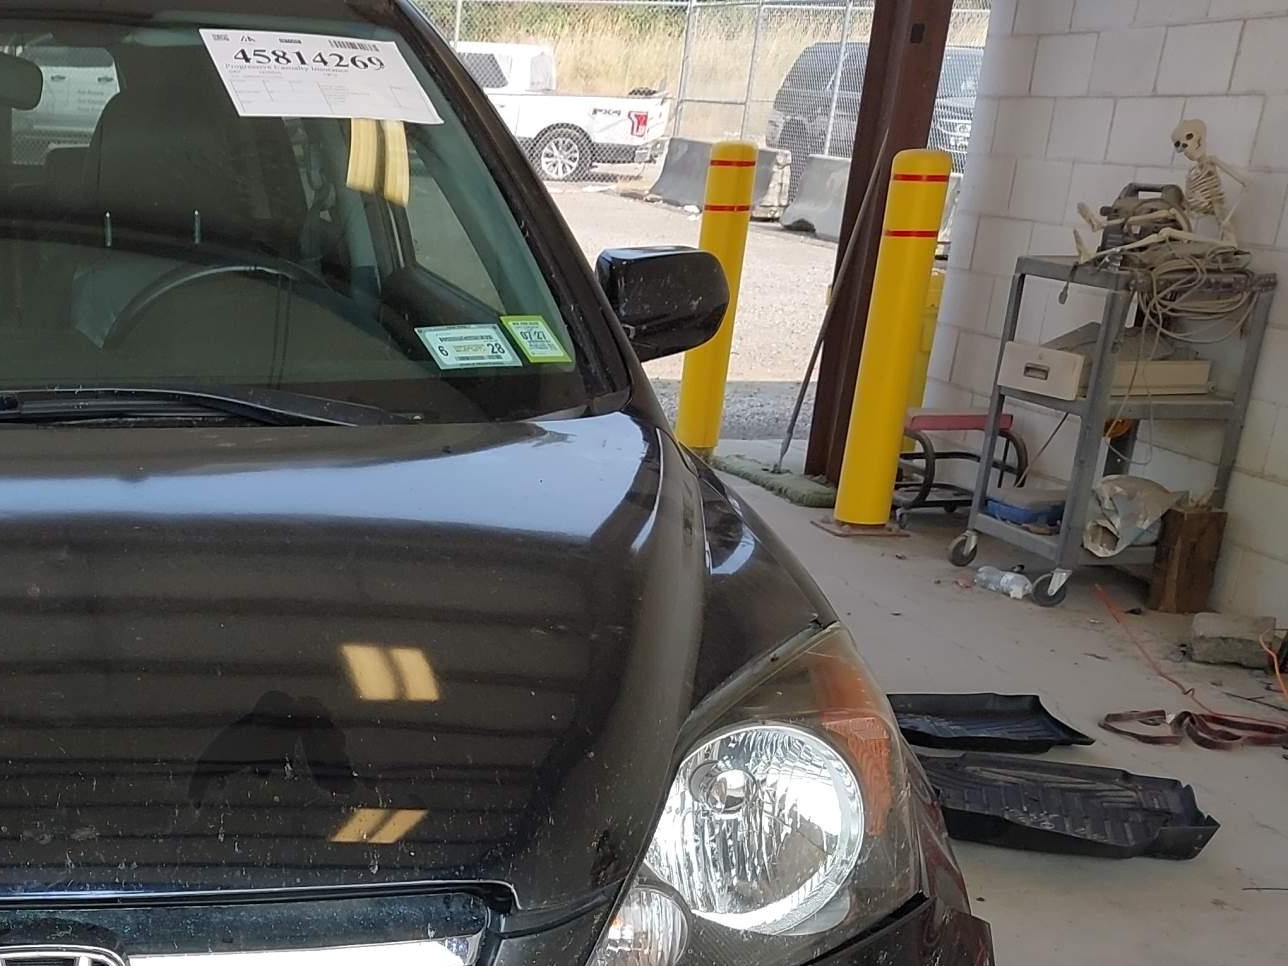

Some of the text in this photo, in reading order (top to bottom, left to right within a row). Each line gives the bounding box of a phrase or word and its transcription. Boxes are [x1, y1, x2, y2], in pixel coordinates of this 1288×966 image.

[233, 48, 385, 71] 45814269
[438, 342, 505, 357] 6 28
